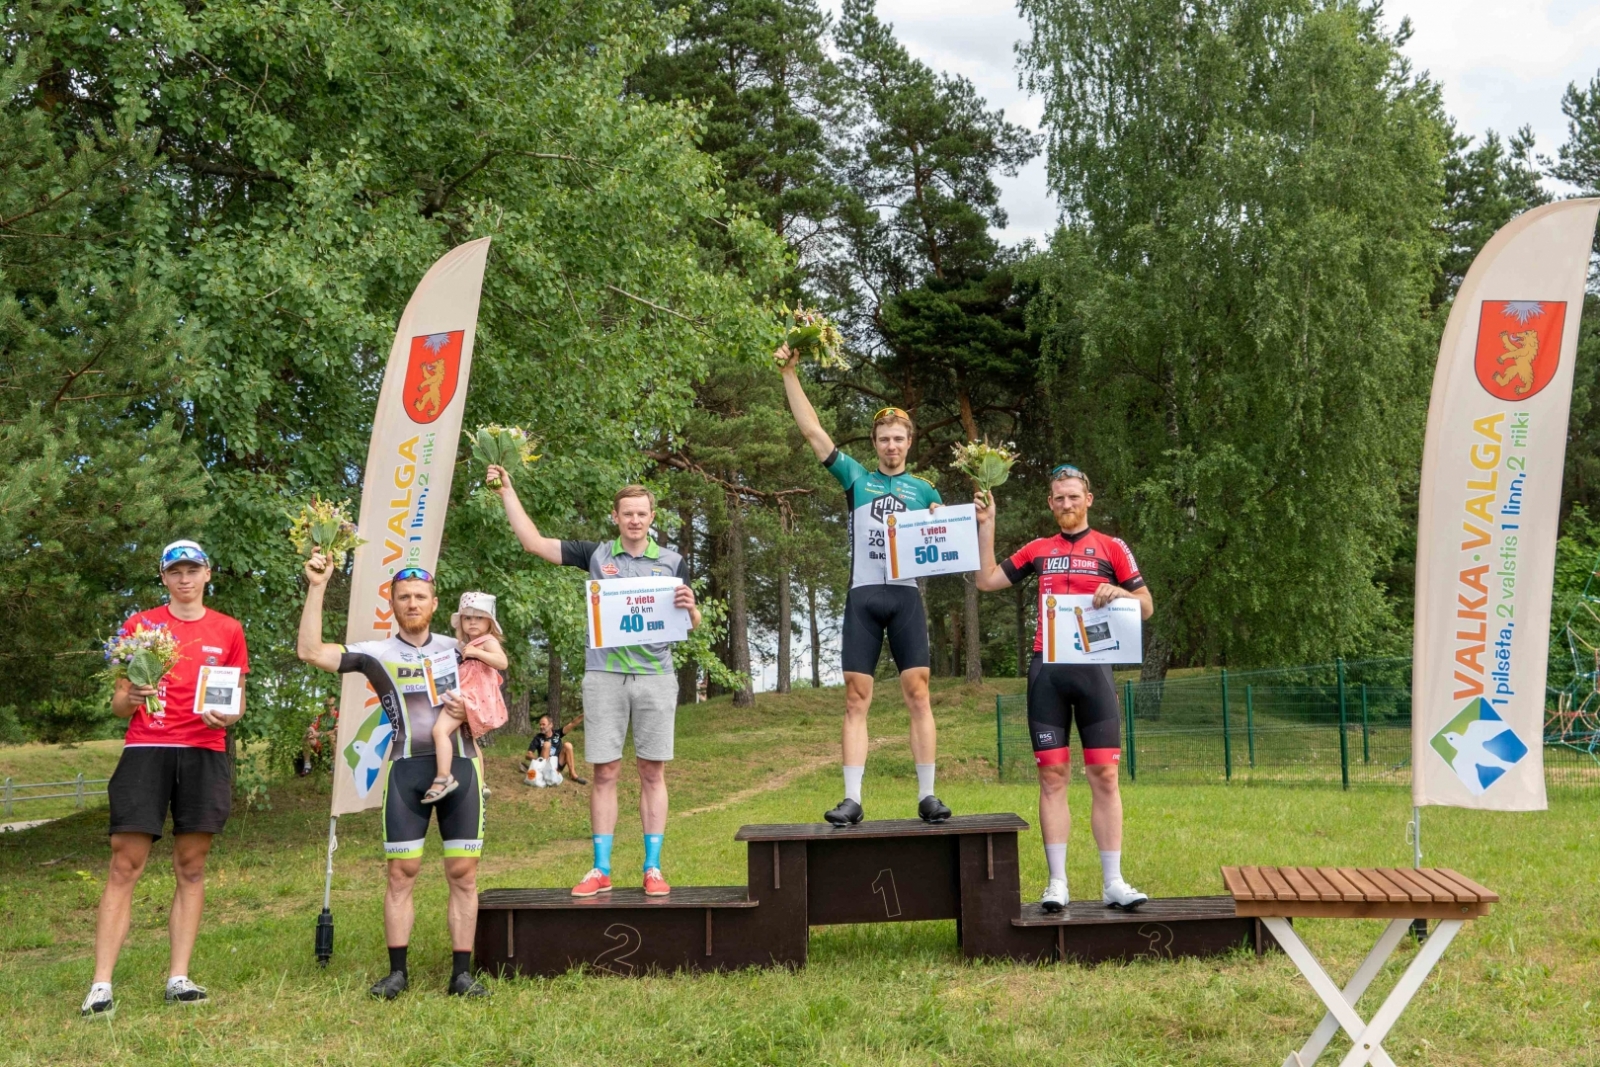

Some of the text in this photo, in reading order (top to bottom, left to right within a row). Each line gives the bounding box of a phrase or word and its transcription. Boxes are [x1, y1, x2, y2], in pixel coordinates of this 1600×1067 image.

[1510, 412, 1530, 447] riiki
[422, 432, 436, 465] riiki
[1506, 456, 1526, 470] 2
[418, 472, 429, 486] 2
[382, 434, 421, 566] VALGA
[1500, 473, 1526, 515] linn,
[410, 487, 429, 528] linn,
[409, 534, 422, 542] 1
[924, 536, 946, 545] 87 km
[927, 526, 947, 535] vieta
[914, 545, 959, 565] 50 EUR
[1072, 559, 1097, 569] STORE
[1453, 412, 1505, 701] VALKA VALGA
[1496, 535, 1518, 599] valstis
[626, 595, 655, 606] 2. vieta
[630, 606, 640, 614] 60
[1496, 603, 1514, 618] 2
[619, 614, 665, 633] 40 EUR
[1491, 622, 1515, 695] pilsēta,
[872, 868, 902, 918] 1
[593, 922, 642, 980] 2
